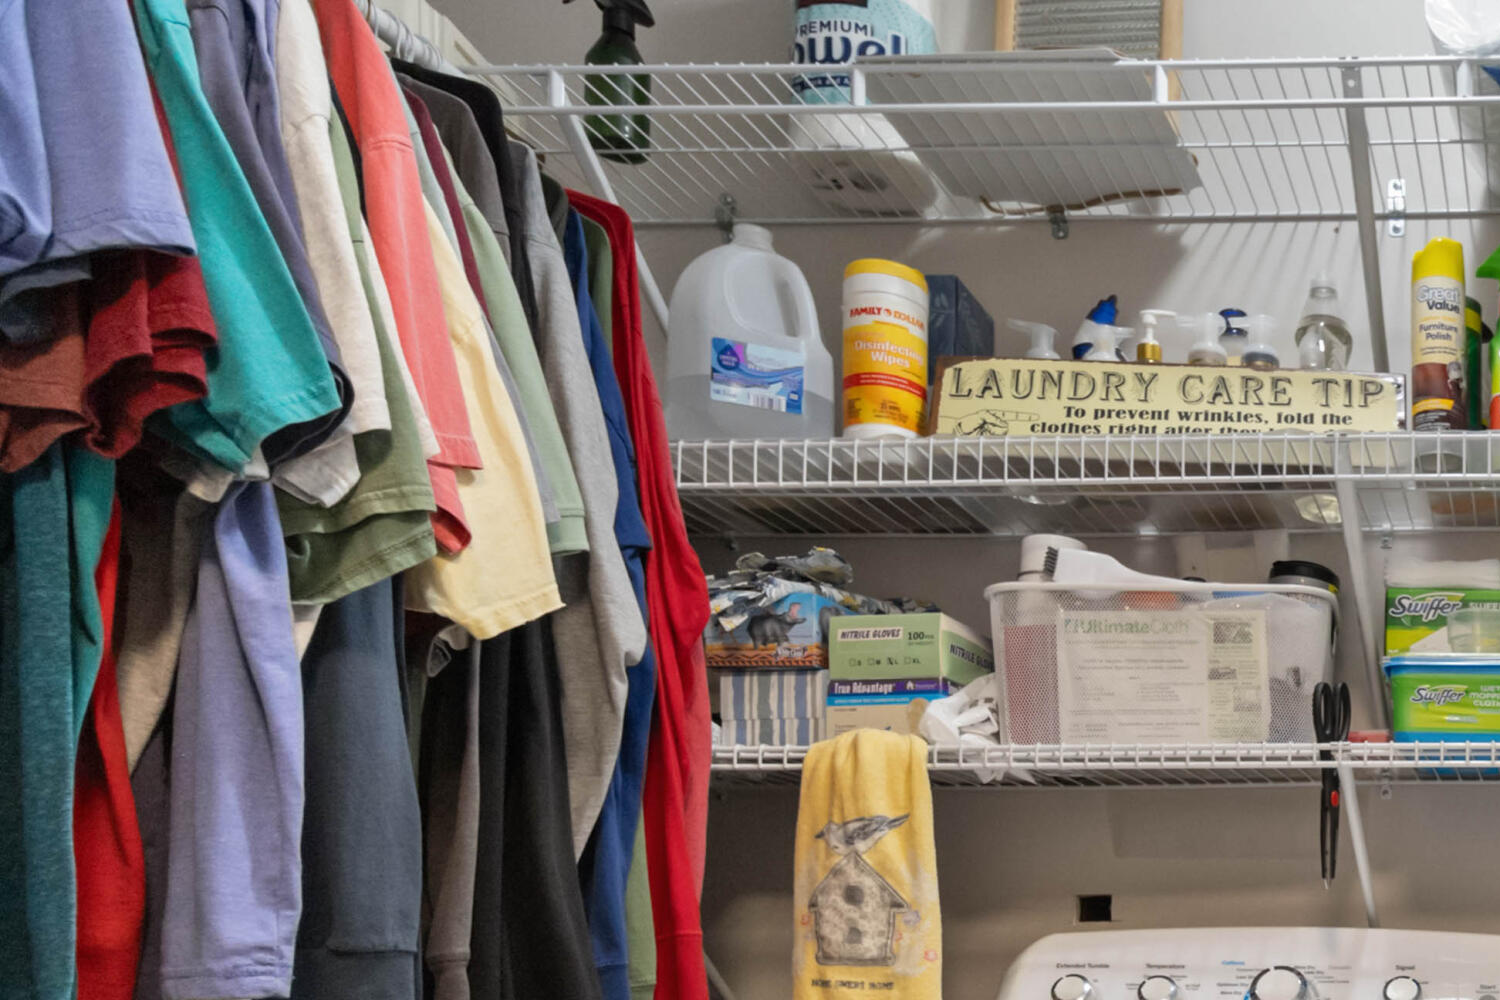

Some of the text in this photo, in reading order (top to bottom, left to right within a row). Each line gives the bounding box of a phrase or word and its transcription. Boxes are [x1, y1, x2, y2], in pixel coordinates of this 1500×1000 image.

[1416, 285, 1459, 303] Great
[1427, 299, 1460, 314] Value
[849, 306, 925, 331] FAMILY DOLLAR
[1419, 323, 1458, 333] Furniture
[1425, 332, 1452, 341] Polish
[854, 340, 924, 367] Disinfecting
[871, 351, 910, 368] Wipes
[948, 366, 1158, 402] LAUNDRY
[1179, 373, 1293, 408] CARE
[1063, 405, 1353, 425] To prevent wrinkles, fold the
[1030, 421, 1101, 435] clothes
[1390, 596, 1461, 621] Swiffer
[841, 629, 901, 640] NITRILE GLOVES
[908, 632, 925, 640] 100
[950, 644, 975, 664] NITRILE
[835, 681, 895, 694] True Advantage
[1411, 687, 1464, 705] Swiffer
[1145, 962, 1186, 970] Temperature
